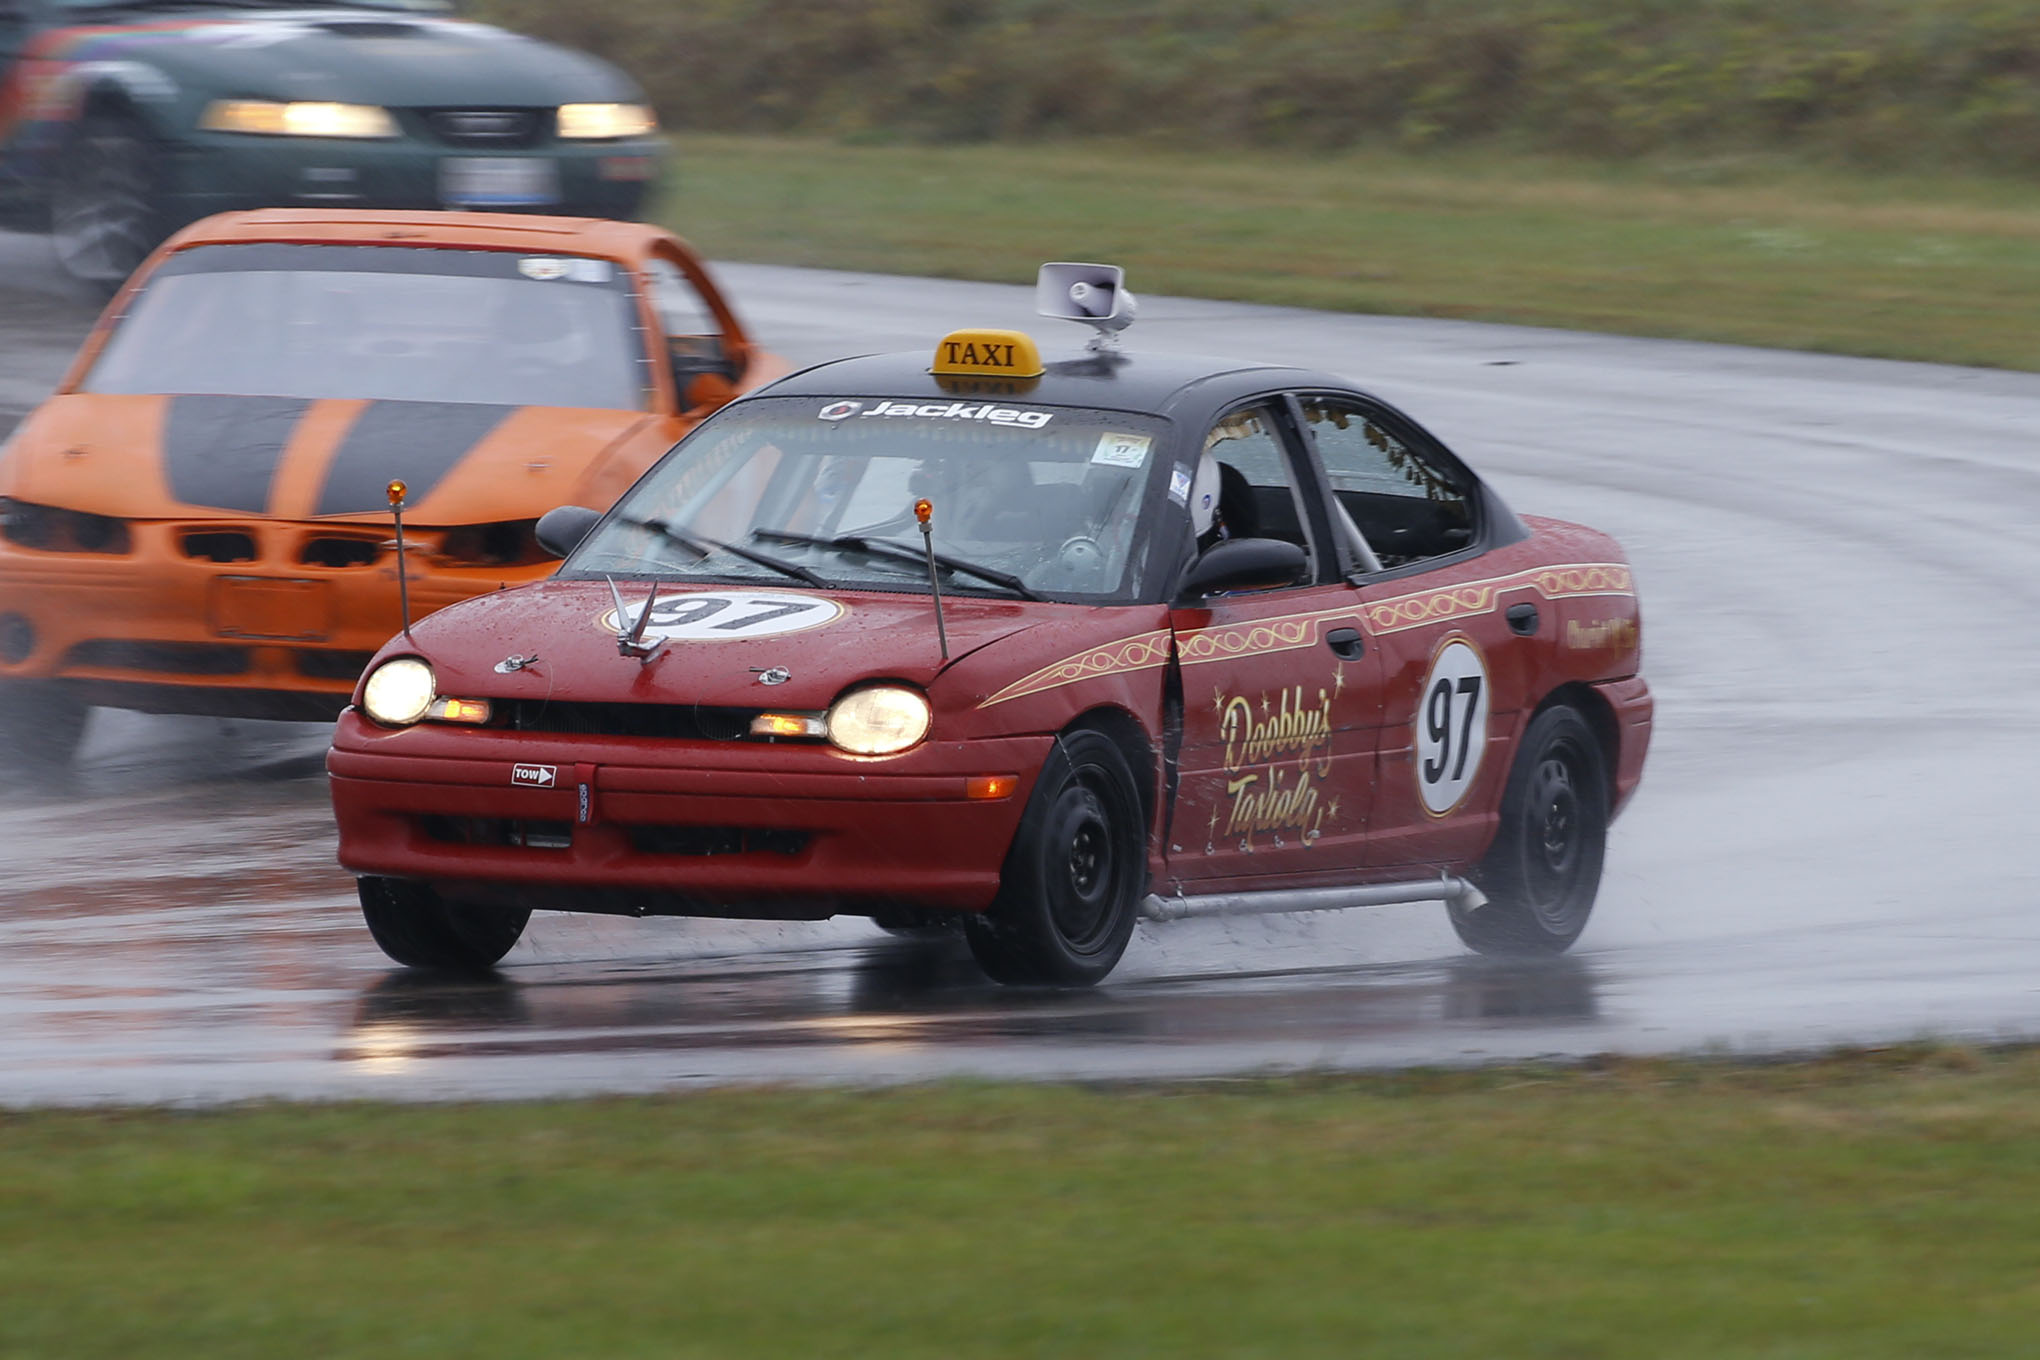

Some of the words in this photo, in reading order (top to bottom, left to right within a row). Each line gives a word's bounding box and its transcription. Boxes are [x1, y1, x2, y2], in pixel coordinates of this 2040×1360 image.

[944, 341, 1015, 367] TAXI
[862, 401, 1054, 429] Jackleg
[629, 598, 821, 630] 97
[1424, 675, 1482, 784] 97
[515, 768, 539, 780] TOW
